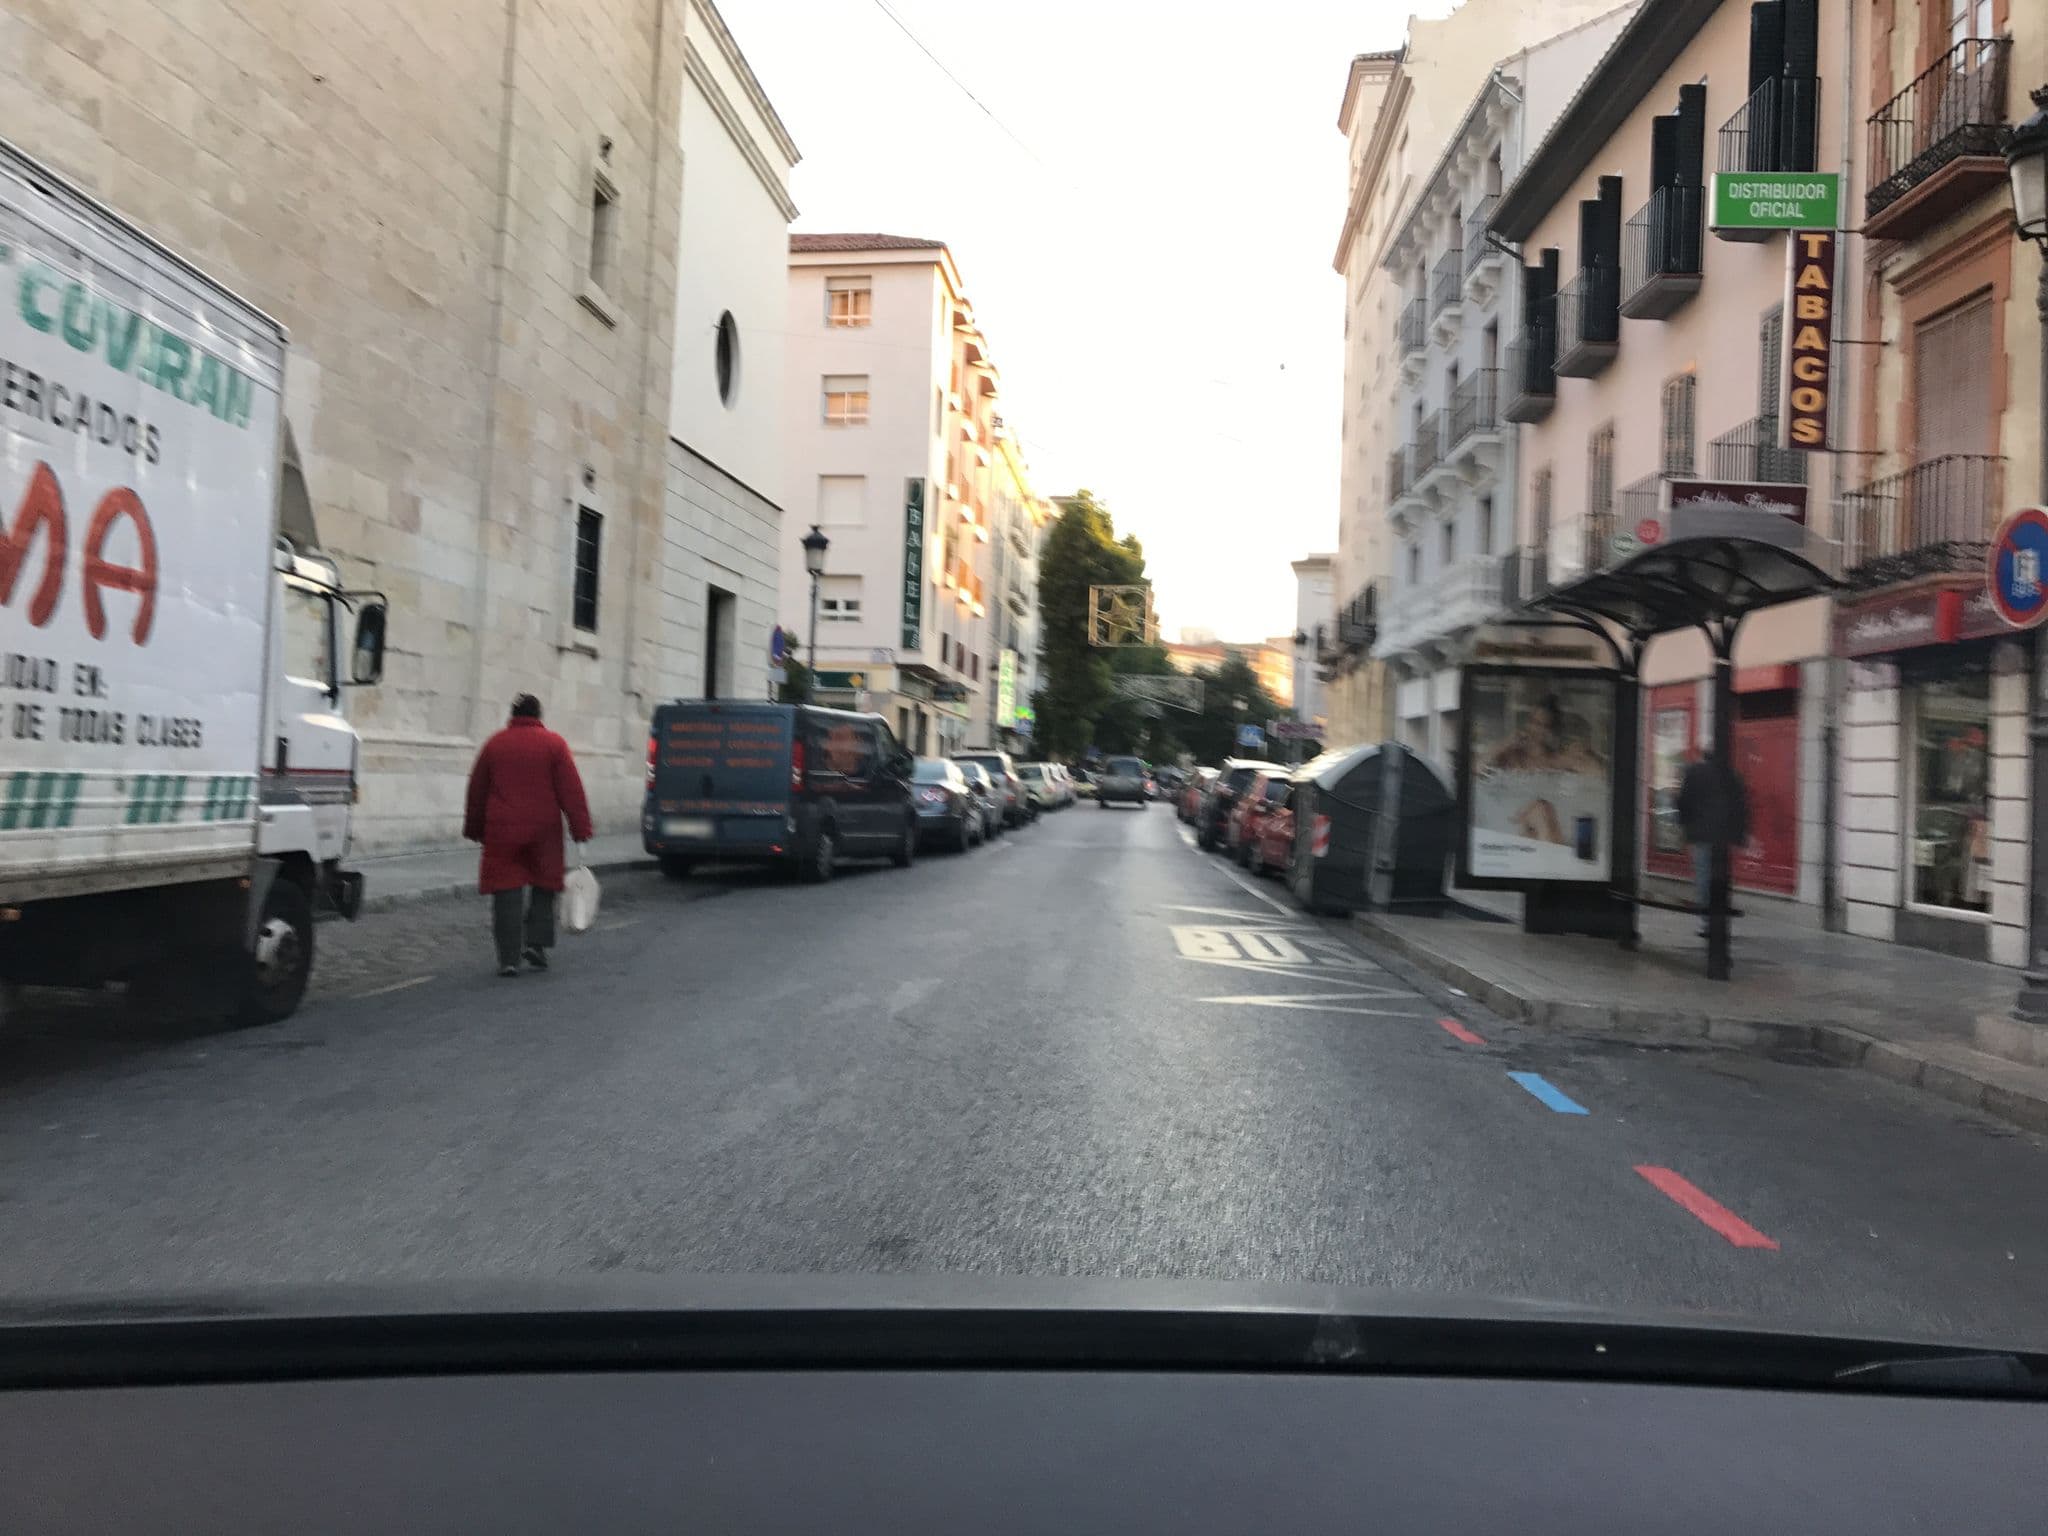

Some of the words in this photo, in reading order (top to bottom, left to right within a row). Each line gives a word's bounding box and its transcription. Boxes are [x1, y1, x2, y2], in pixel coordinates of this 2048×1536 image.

[1728, 182, 1827, 199] DISTRIBUIDOR
[1749, 202, 1806, 219] OFICIAL
[1791, 234, 1831, 444] TABACOS
[0, 357, 161, 466] ERCADOS
[1170, 926, 1385, 971] BUS
